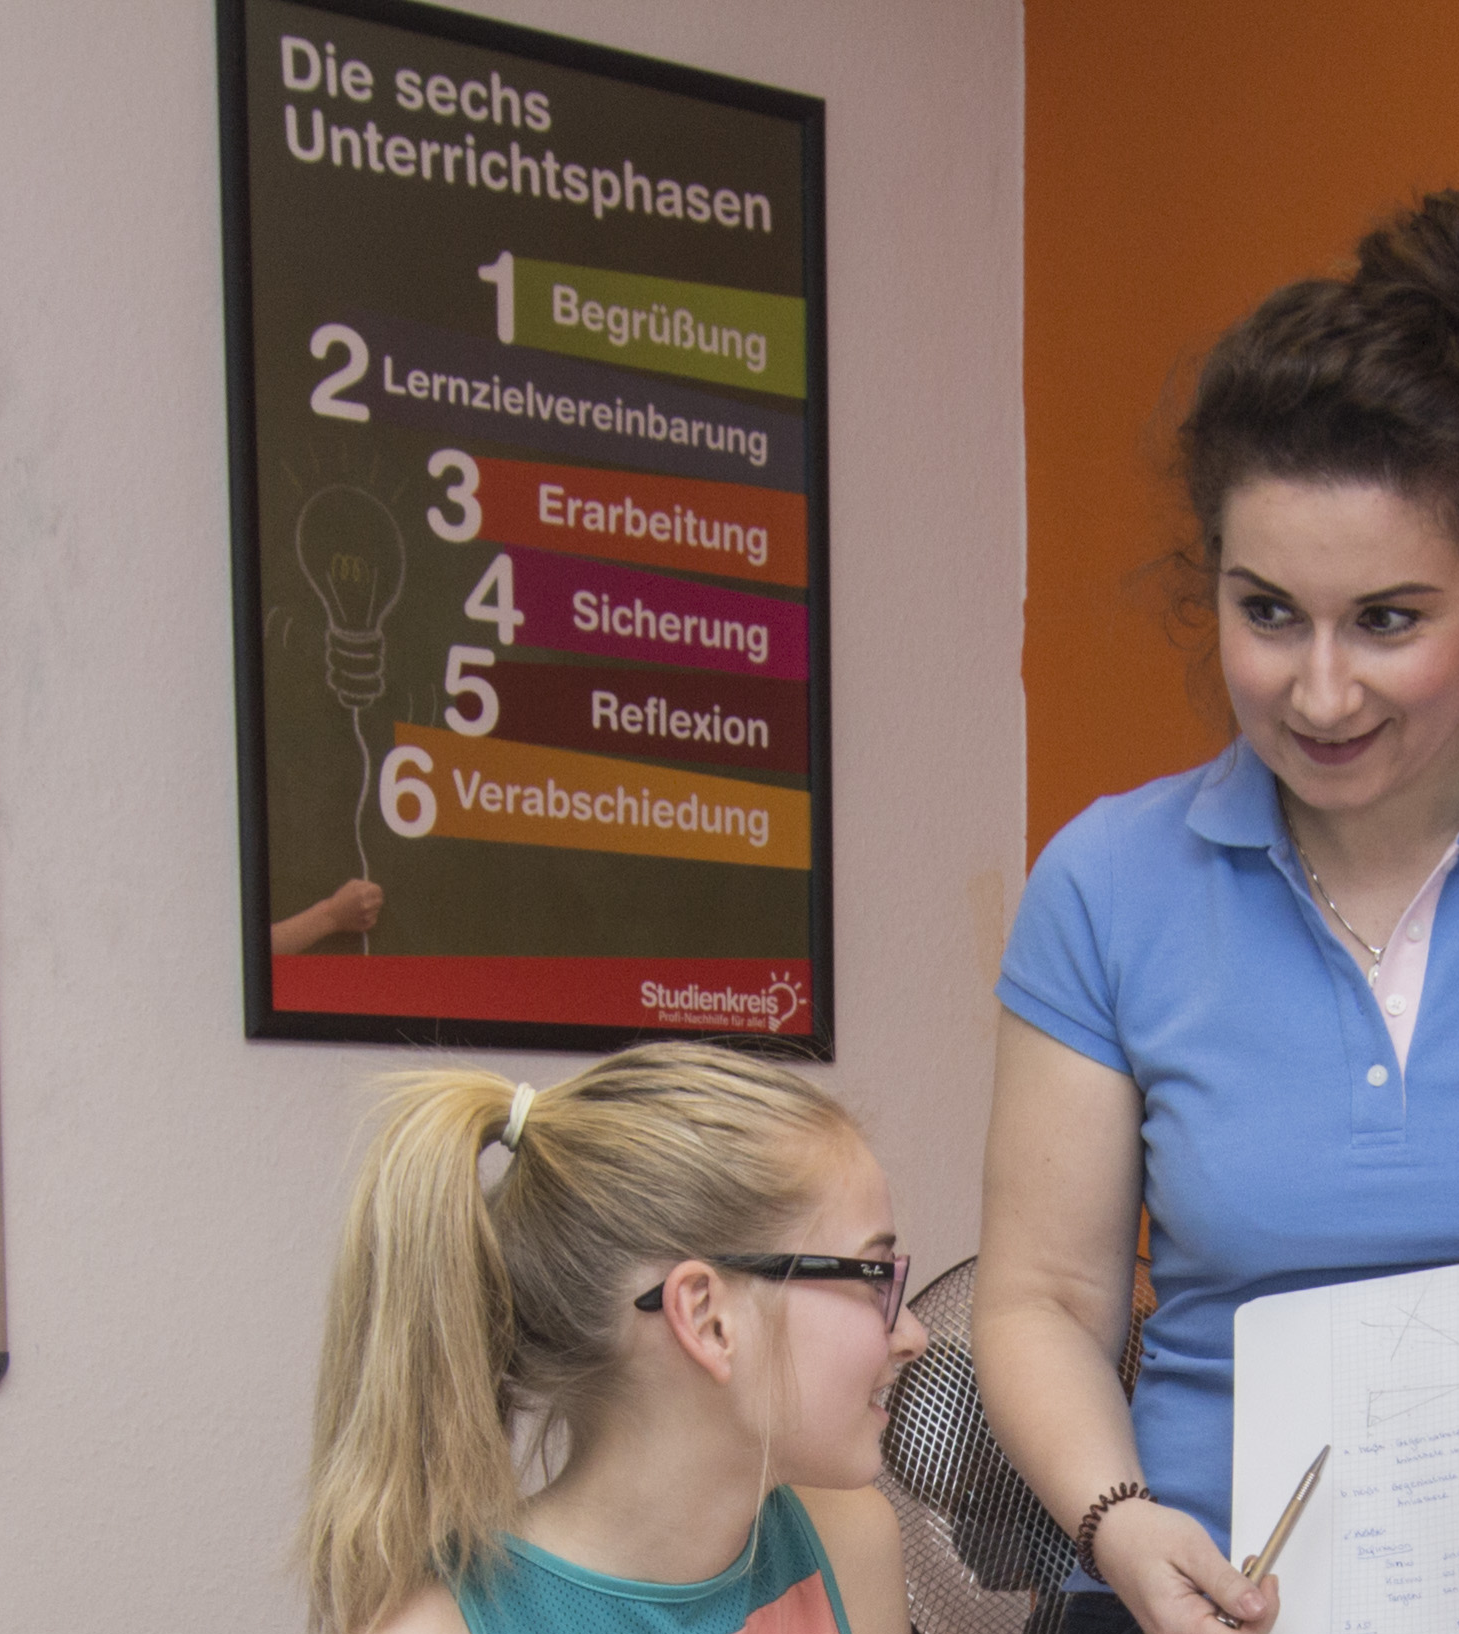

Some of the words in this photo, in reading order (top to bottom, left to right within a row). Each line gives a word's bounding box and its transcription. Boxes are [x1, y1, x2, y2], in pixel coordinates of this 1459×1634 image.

[281, 35, 374, 101] Die
[395, 71, 553, 132] sechs
[284, 105, 772, 232] Unterrichtsphasen
[478, 250, 515, 345] 1
[553, 284, 767, 372] Begrüßung
[309, 324, 370, 422] 2
[383, 355, 769, 467] Lernzielvereinbarung
[427, 447, 483, 543] 3
[539, 484, 769, 566] Erarbeitung
[465, 553, 525, 645] 4
[572, 590, 770, 664] Sicherung
[444, 644, 500, 737] 5
[591, 690, 770, 748] Reflexion
[379, 745, 437, 839] 6
[452, 769, 771, 847] Verabschiedung
[641, 980, 779, 1015] Studienkreis
[659, 1010, 729, 1026] Profi-Nachhilfe
